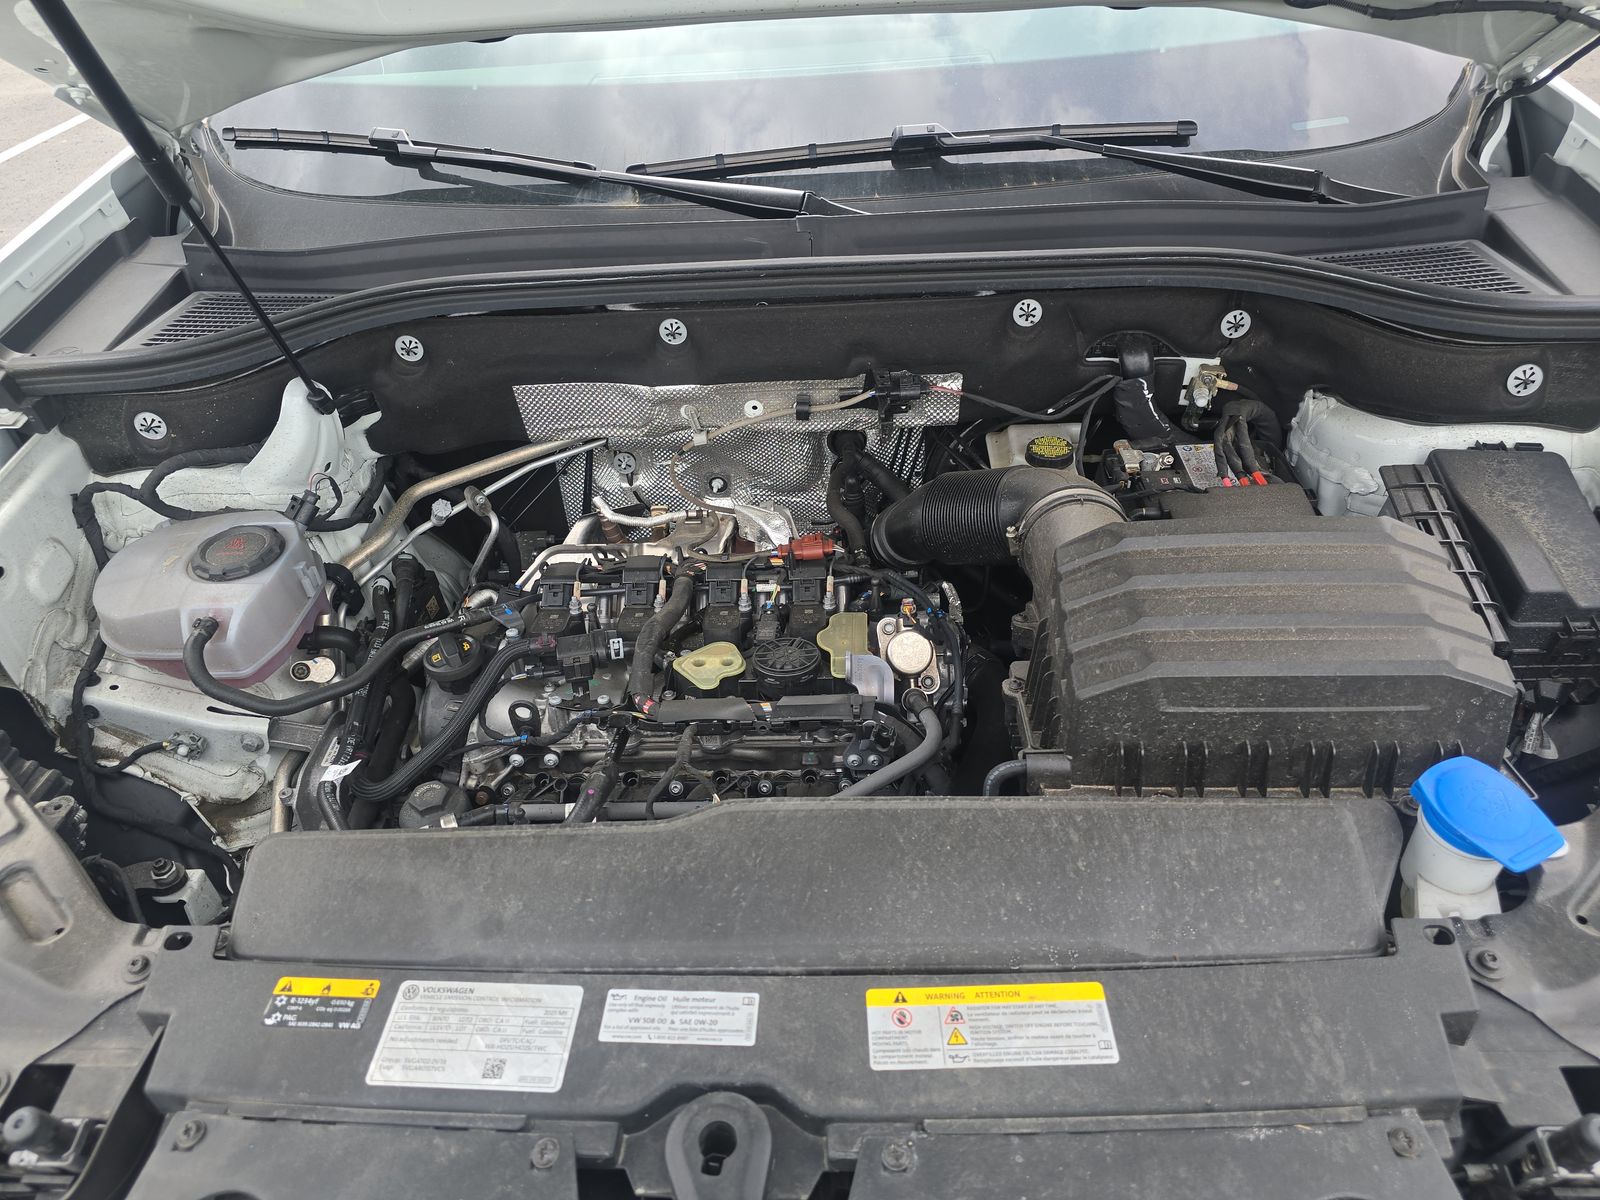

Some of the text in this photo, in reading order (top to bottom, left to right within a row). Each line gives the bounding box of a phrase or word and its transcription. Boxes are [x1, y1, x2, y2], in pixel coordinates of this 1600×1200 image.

[422, 986, 475, 994] VOLKSWAGEN
[634, 995, 656, 1003] Engine
[925, 990, 1021, 1000] WARNING ATTENTION
[656, 1017, 668, 1025] 00
